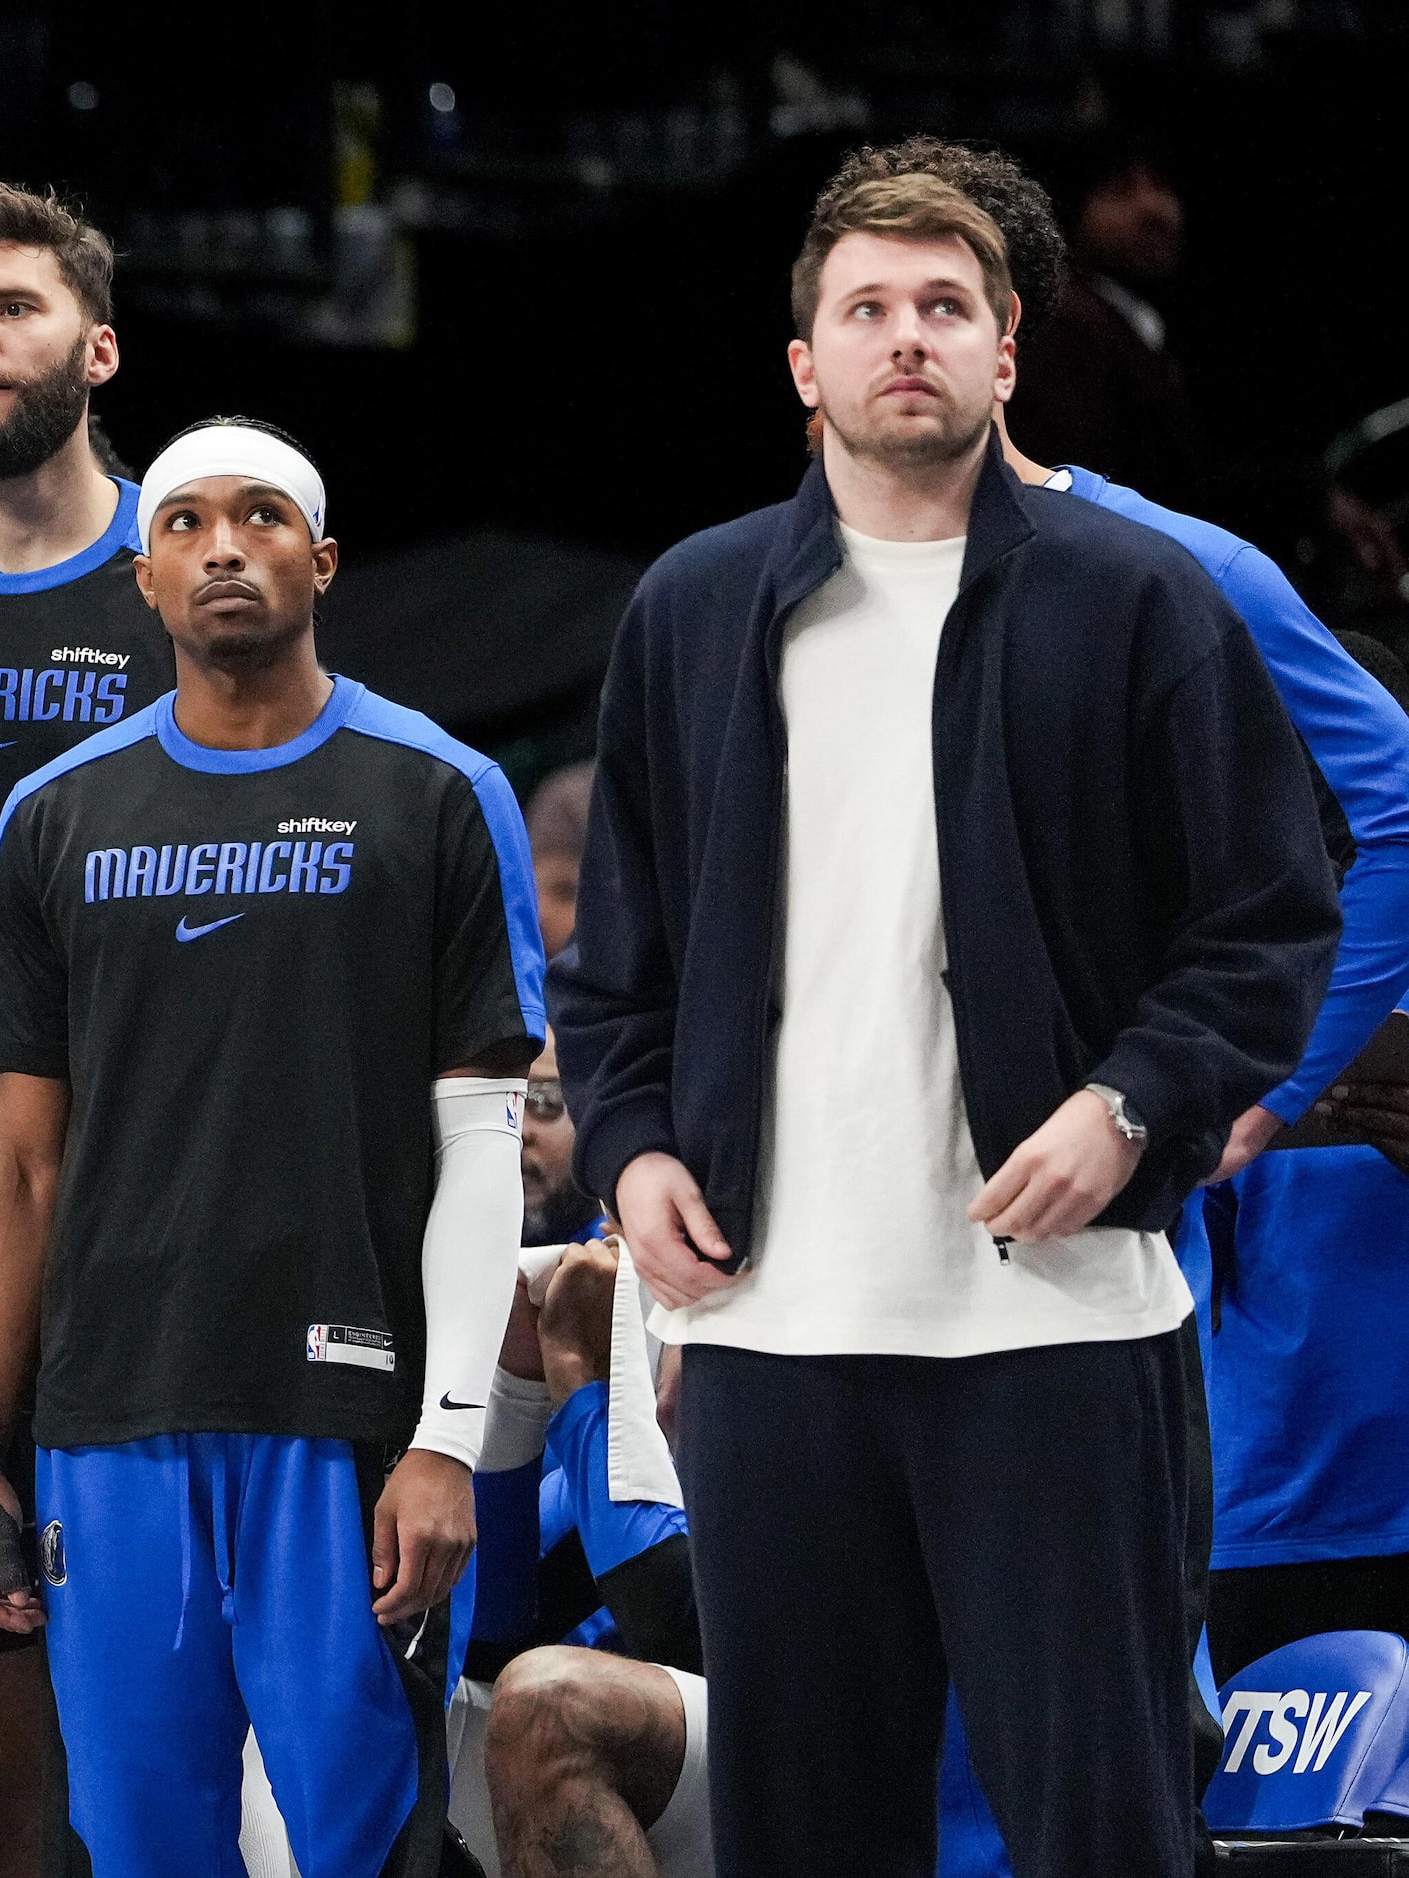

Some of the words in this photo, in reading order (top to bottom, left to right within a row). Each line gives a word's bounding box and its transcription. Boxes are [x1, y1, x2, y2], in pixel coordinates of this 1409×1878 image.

[51, 647, 130, 669] shiftkey
[277, 817, 357, 835] shiftkey
[85, 841, 354, 903] MAVERICKS
